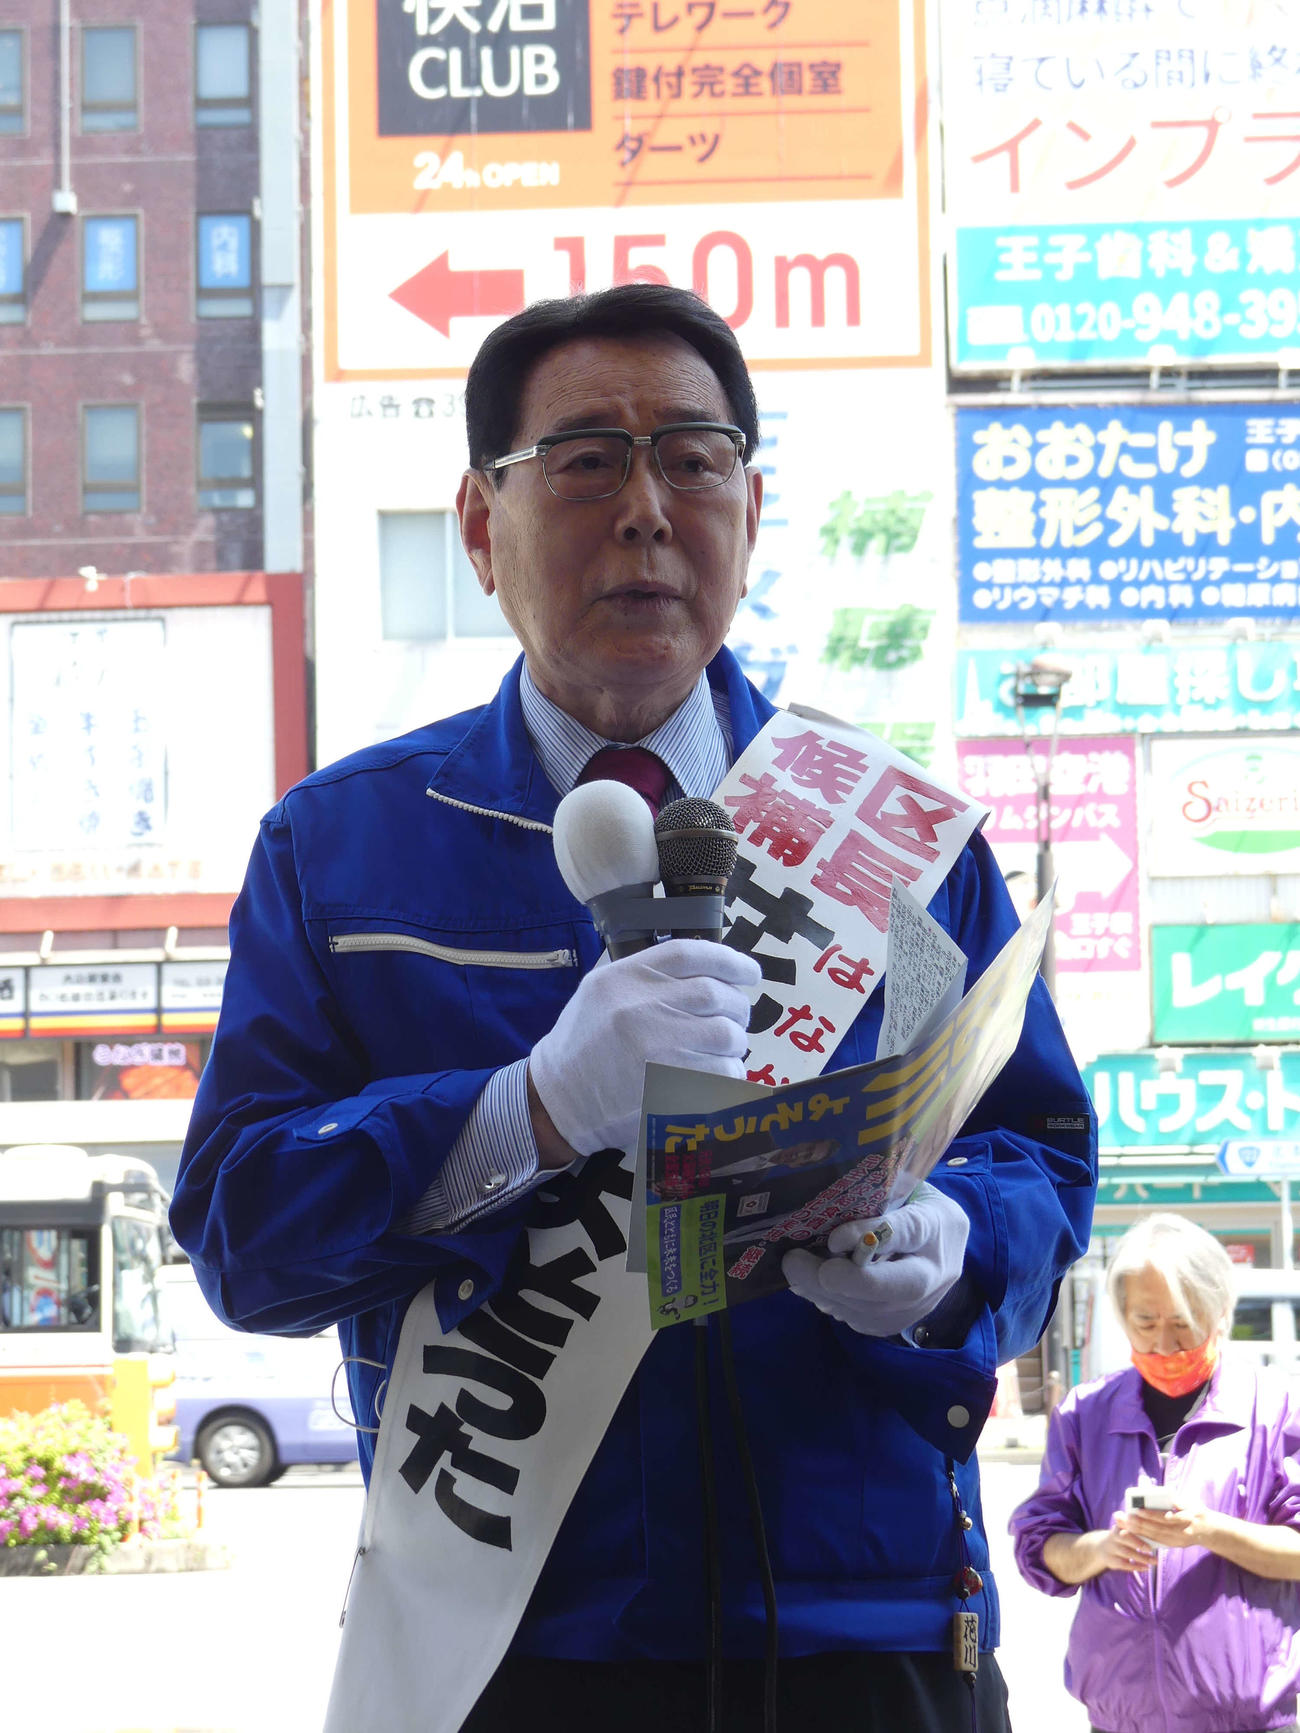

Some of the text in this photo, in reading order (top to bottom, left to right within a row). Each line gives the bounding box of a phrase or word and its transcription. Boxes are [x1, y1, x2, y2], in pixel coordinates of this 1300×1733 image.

[612, 0, 791, 36] テレワーク
[407, 44, 561, 99] CLUB
[611, 60, 844, 101] 鍵付完全個室
[973, 45, 1300, 93] 寝ている間に終
[614, 132, 722, 168] ダーツ
[1030, 288, 1300, 343] 0120-948-39
[972, 419, 1217, 481] おおたけ
[1117, 556, 1300, 582] リハビリテーショ
[992, 585, 1112, 610] リウマチ科
[724, 730, 870, 868] 候補
[962, 1616, 978, 1669] 花川
